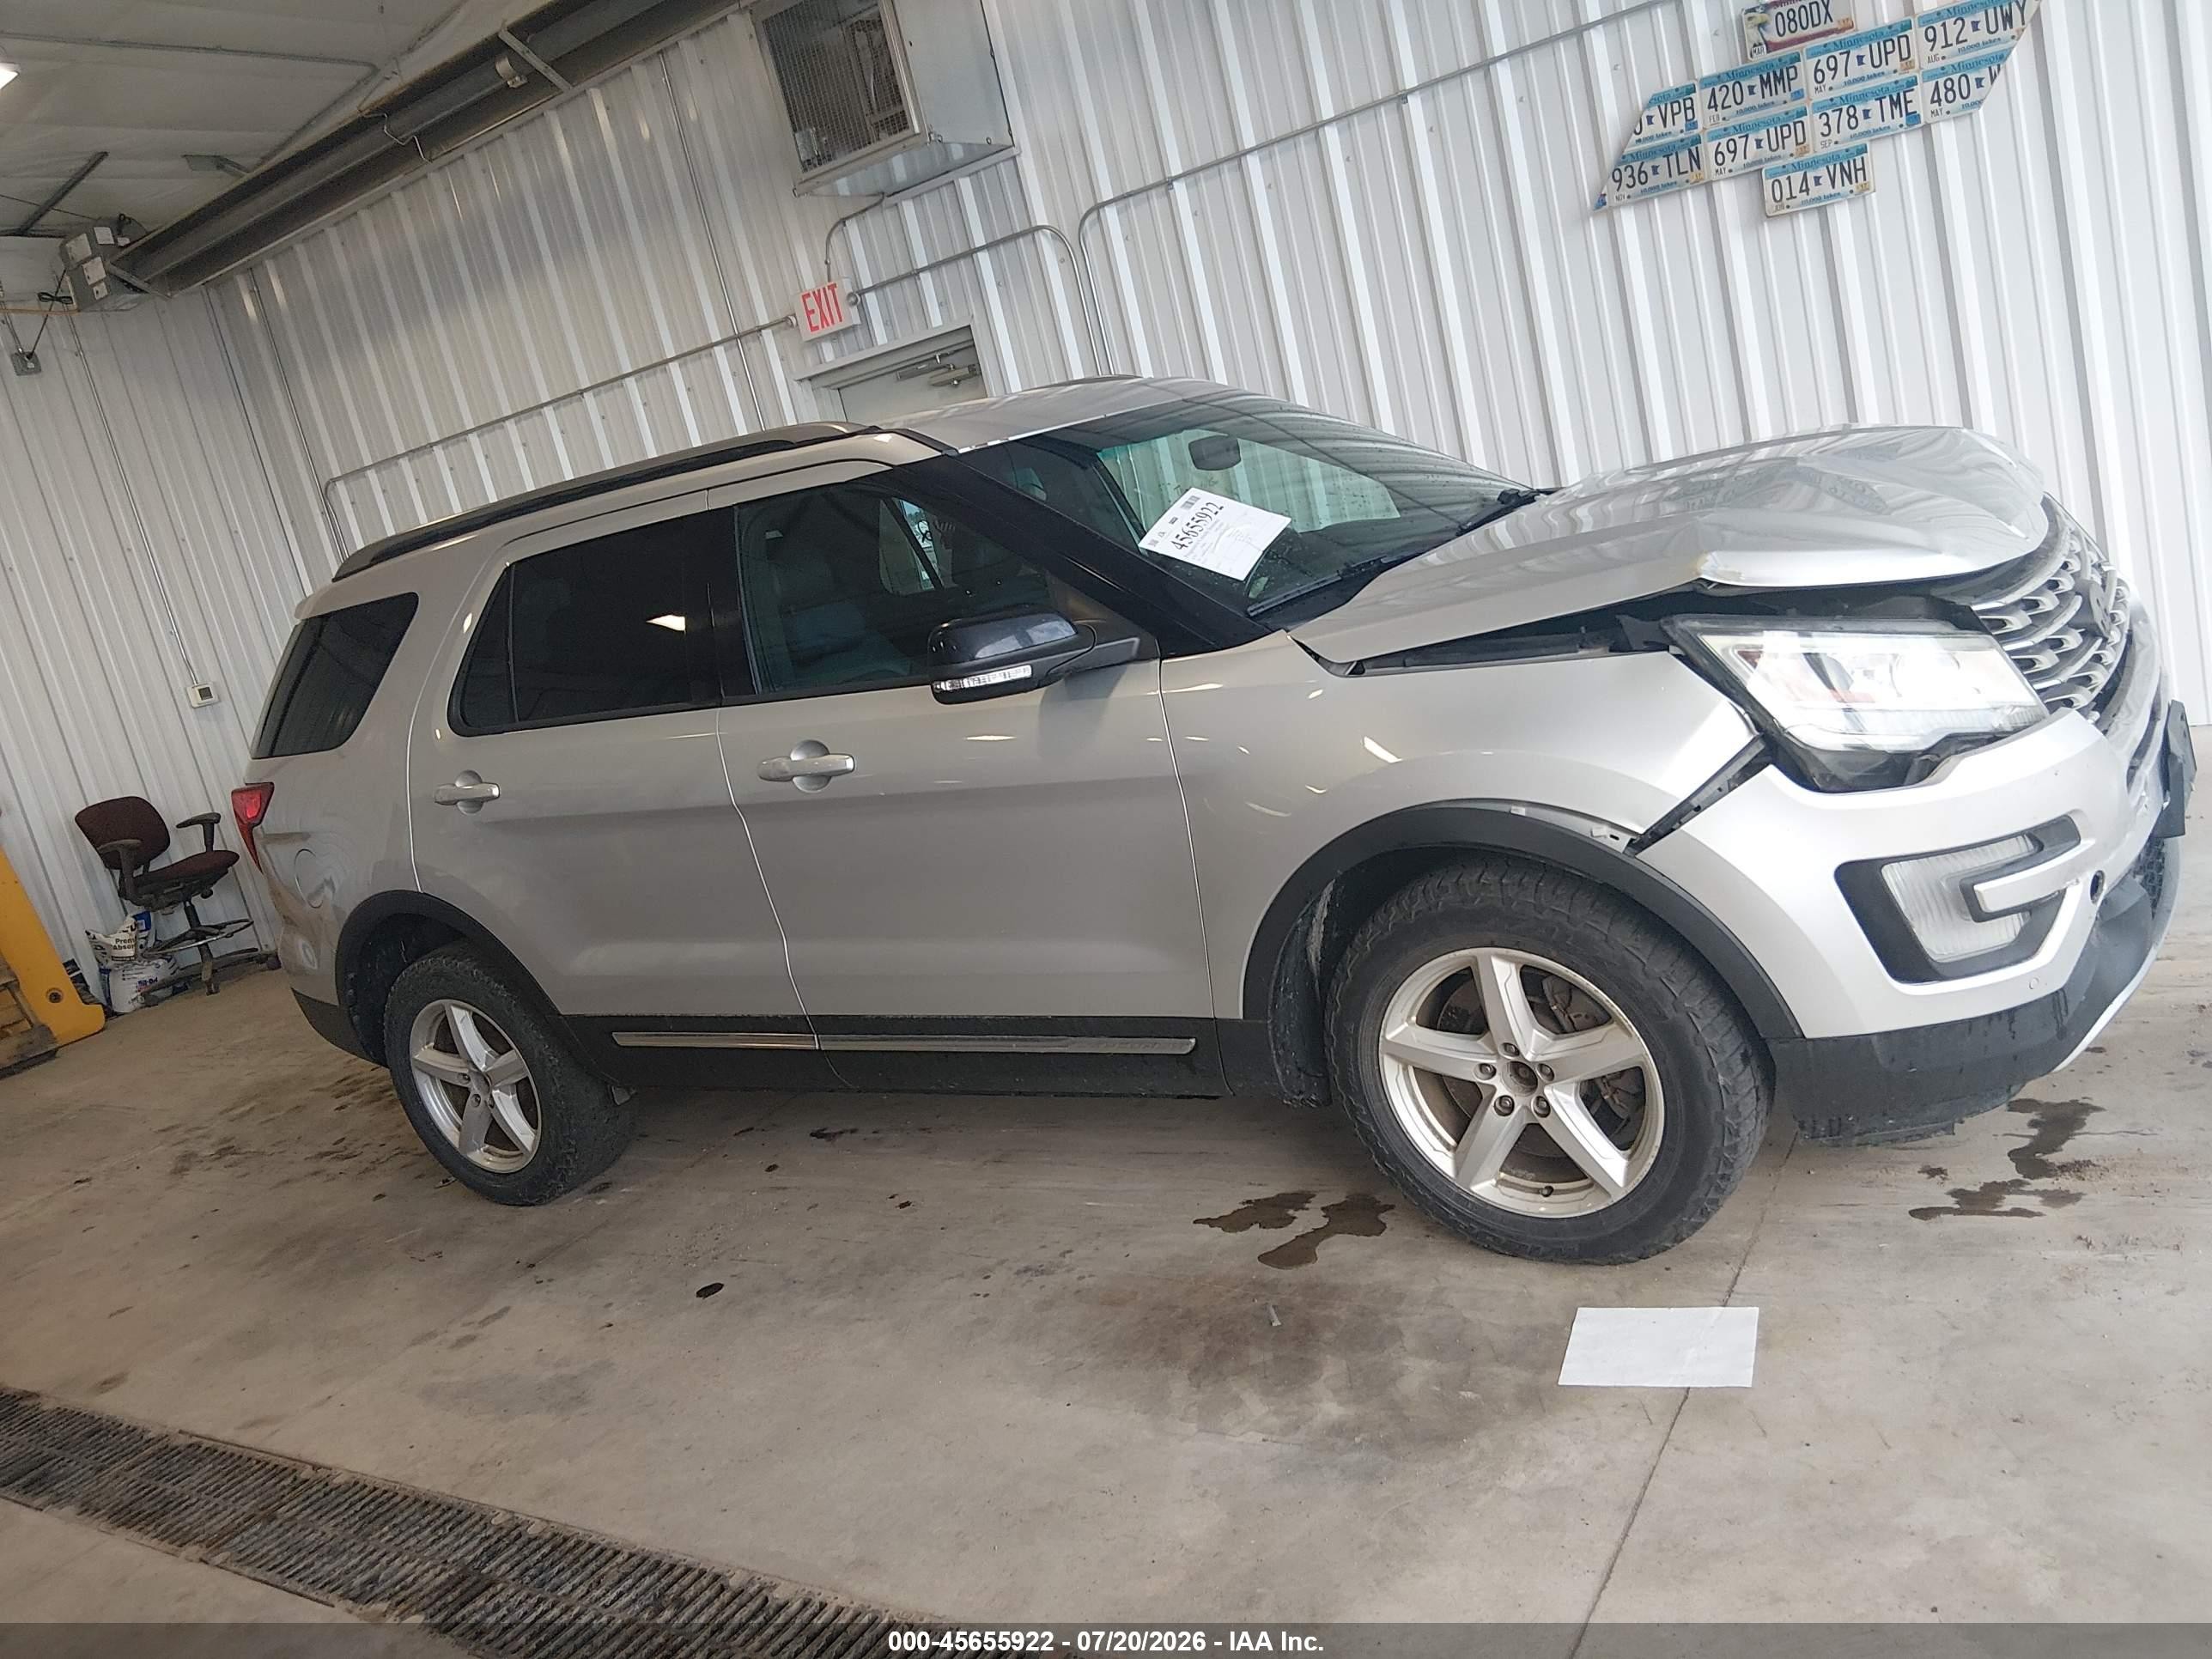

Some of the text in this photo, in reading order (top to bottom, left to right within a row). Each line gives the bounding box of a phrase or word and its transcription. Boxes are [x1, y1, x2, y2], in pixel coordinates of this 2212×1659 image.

[1924, 0, 2027, 52] 912 UWY
[1833, 31, 1885, 50] Minnesota
[1814, 33, 1911, 84] 697 UPD
[1927, 53, 1941, 64] AUG
[1726, 63, 1774, 81] Minnesota
[1867, 70, 1886, 82] lakes
[1707, 64, 1798, 112] 420 MMP
[1814, 83, 1827, 95] MAY
[1839, 85, 1890, 104] Minnesota
[1929, 73, 1972, 107] 480
[1657, 96, 1696, 129] VPB
[1819, 88, 1917, 137] 378 TME
[1930, 108, 1944, 118] MAY
[1730, 115, 1781, 134] Minnesota
[1630, 143, 1677, 161] Minnesota
[1714, 119, 1807, 167] 697 UPD
[1820, 138, 1833, 149] SEP
[1611, 146, 1702, 192] 936 TLN
[1715, 167, 1727, 177] MAY
[1790, 153, 1841, 172] Minnesota
[1771, 155, 1867, 204] 014 VNH
[801, 282, 843, 333] EXIT
[1170, 501, 1224, 550] 45655922
